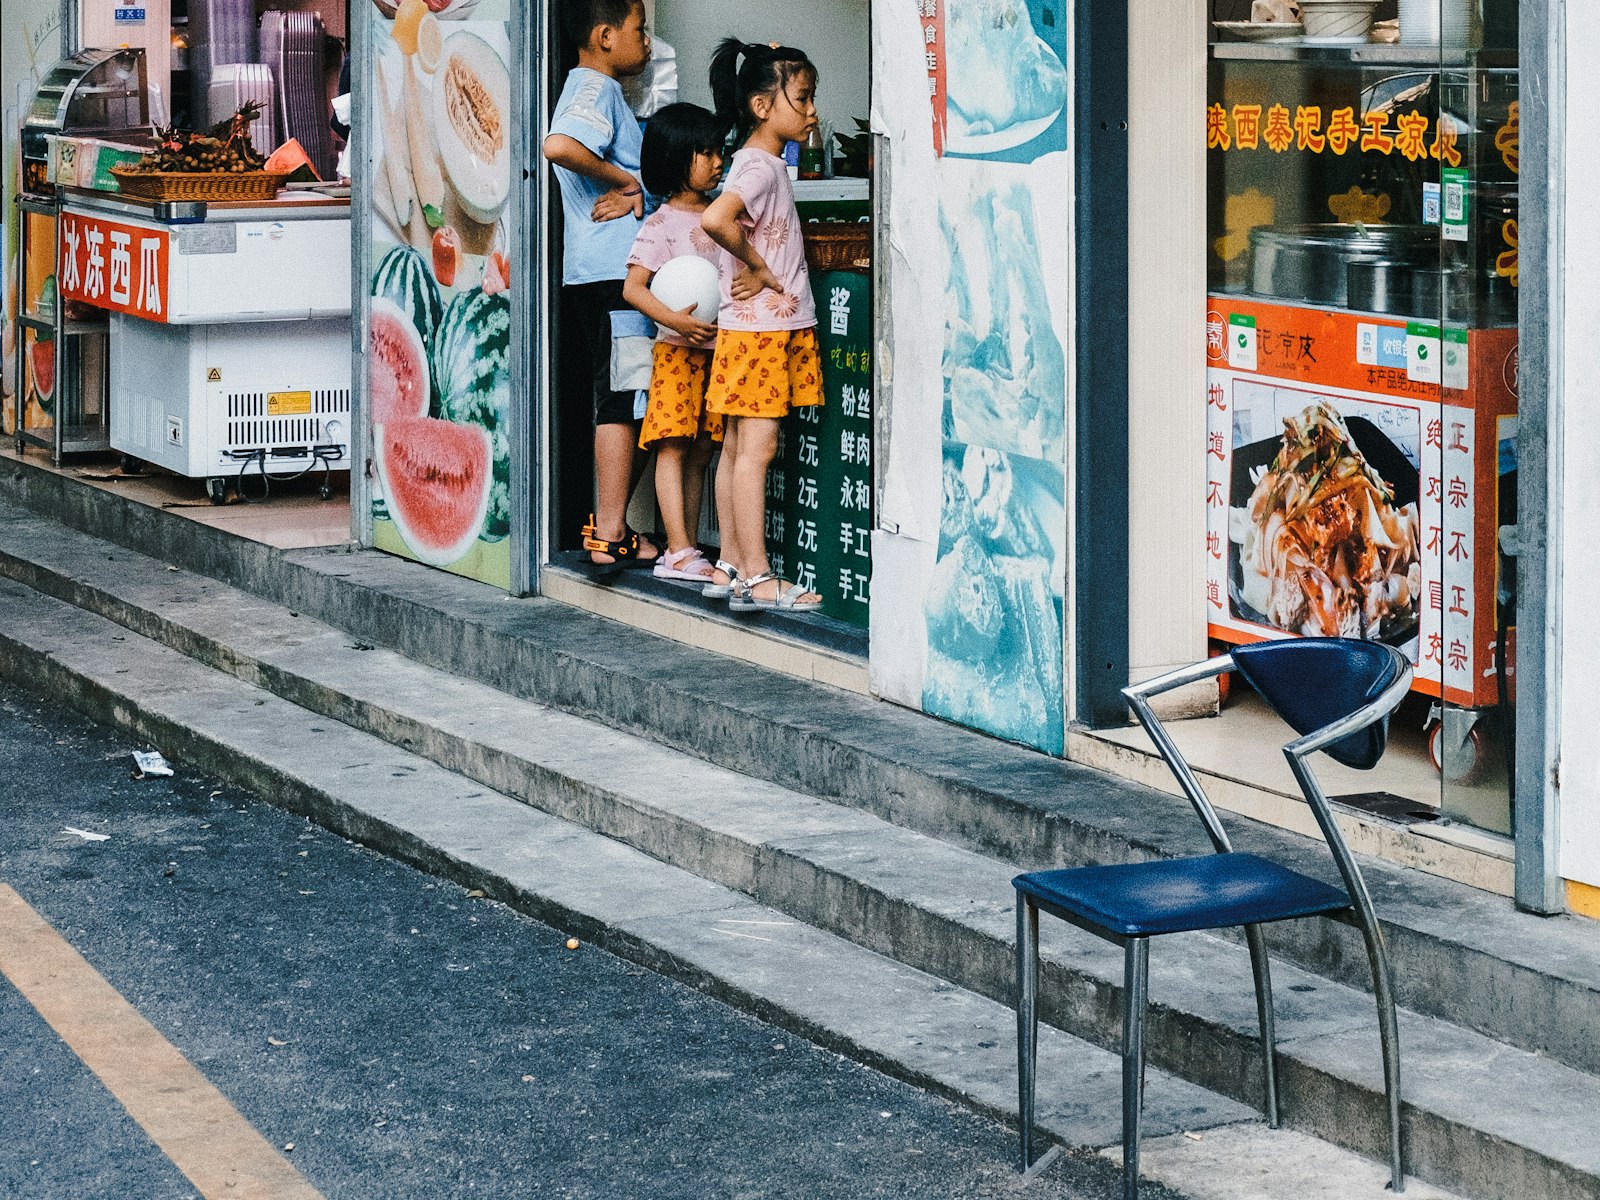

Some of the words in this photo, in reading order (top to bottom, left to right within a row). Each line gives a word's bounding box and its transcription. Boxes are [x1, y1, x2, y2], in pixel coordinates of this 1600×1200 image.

[63, 219, 161, 315] 冰冻西瓜
[829, 286, 850, 336] 酱
[841, 383, 870, 419] 粉丝
[798, 434, 819, 468] 2元
[840, 427, 870, 467] 鲜肉
[798, 476, 819, 510] 2元
[840, 474, 870, 512] 永和
[1206, 382, 1227, 610] 地道不地道
[797, 519, 818, 553] 2元
[839, 522, 869, 558] 手工
[1447, 421, 1469, 672] 正宗不正宗
[796, 561, 817, 595] 2元
[838, 567, 868, 604] 手工
